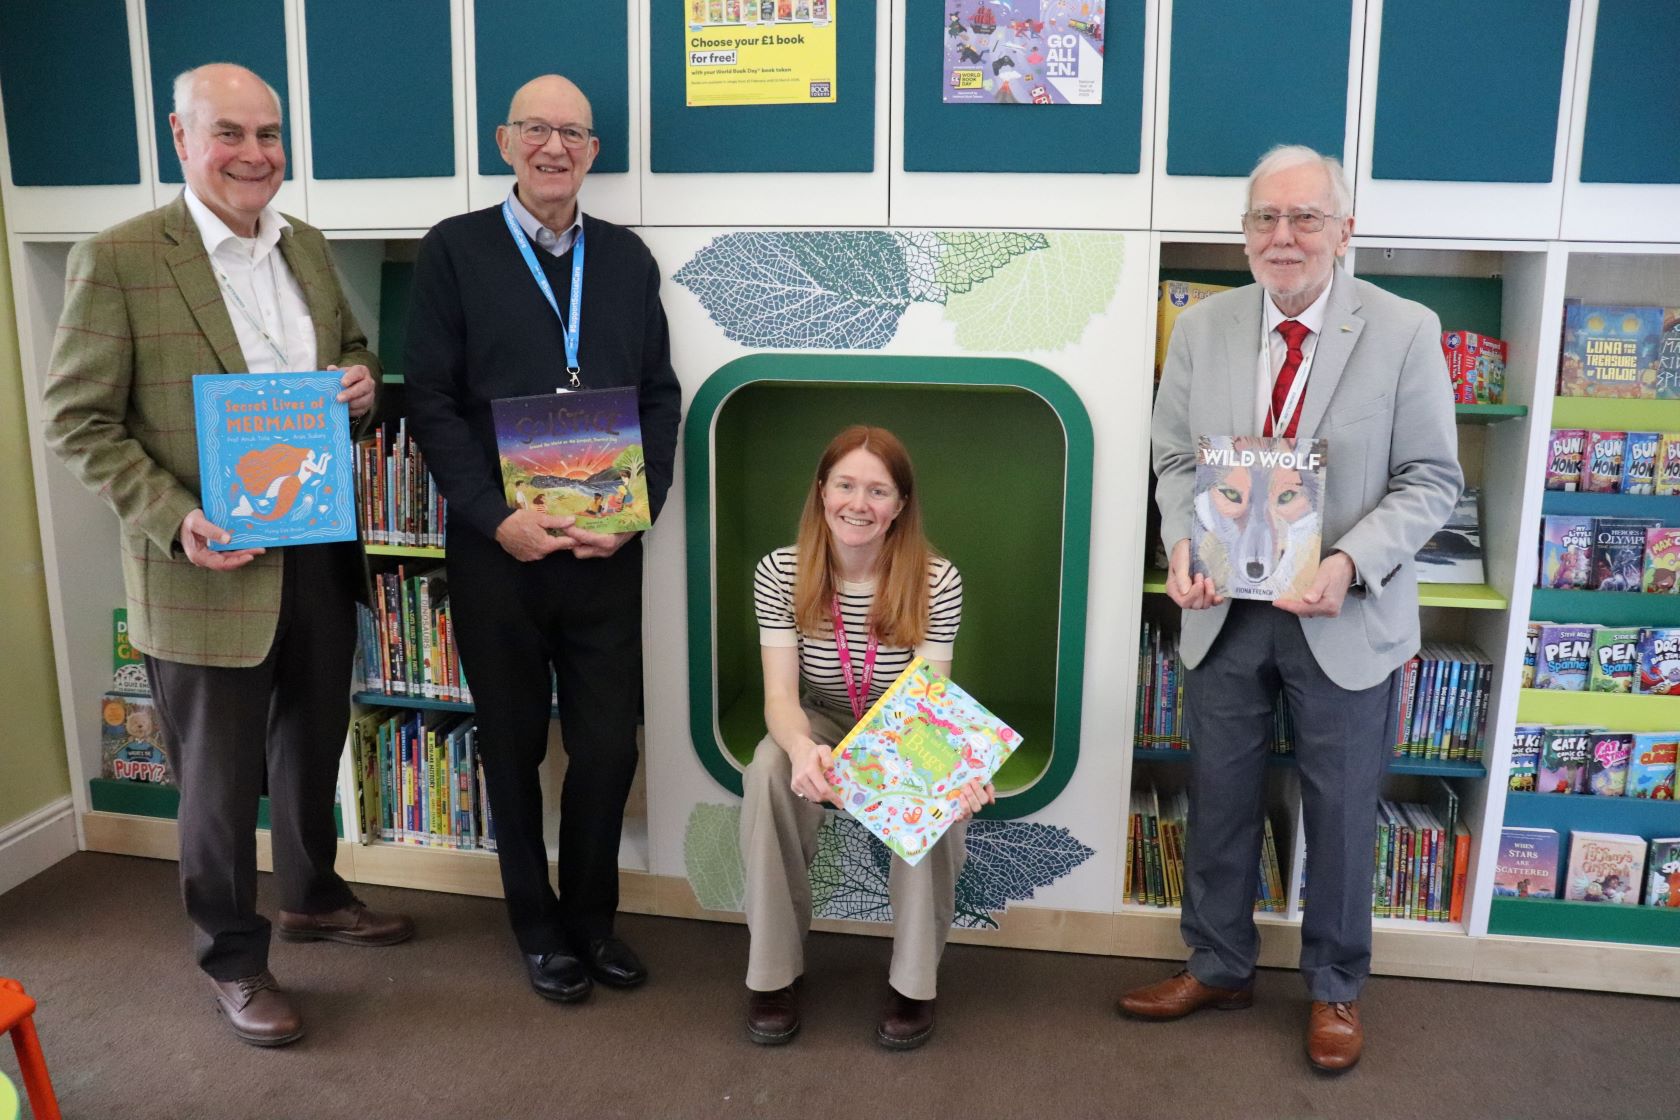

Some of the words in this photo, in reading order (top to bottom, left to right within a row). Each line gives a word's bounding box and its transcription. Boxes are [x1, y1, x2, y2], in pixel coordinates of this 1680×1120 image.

[691, 37, 733, 48] Choose
[735, 37, 760, 49] your
[762, 36, 774, 45] £1
[776, 34, 805, 45] book
[1046, 34, 1076, 48] GO
[691, 53, 708, 63] for
[710, 52, 736, 63] free!
[1046, 48, 1076, 62] ALL
[1046, 62, 1076, 76] IN.
[1586, 341, 1622, 354] LUNA
[1586, 354, 1637, 367] TREASURE
[224, 400, 267, 412] Secret
[272, 398, 305, 410] Lives
[311, 396, 324, 409] of
[227, 413, 326, 432] MERMAIDS
[1202, 448, 1255, 466] WILD
[1260, 452, 1321, 470] WOLF
[420, 598, 431, 650] DINOSAURS
[1552, 738, 1576, 751] CAT
[906, 733, 945, 772] Bugs
[114, 759, 165, 781] PUPPY?
[1508, 850, 1538, 859] STARS
[1496, 866, 1549, 877] SCATTERED
